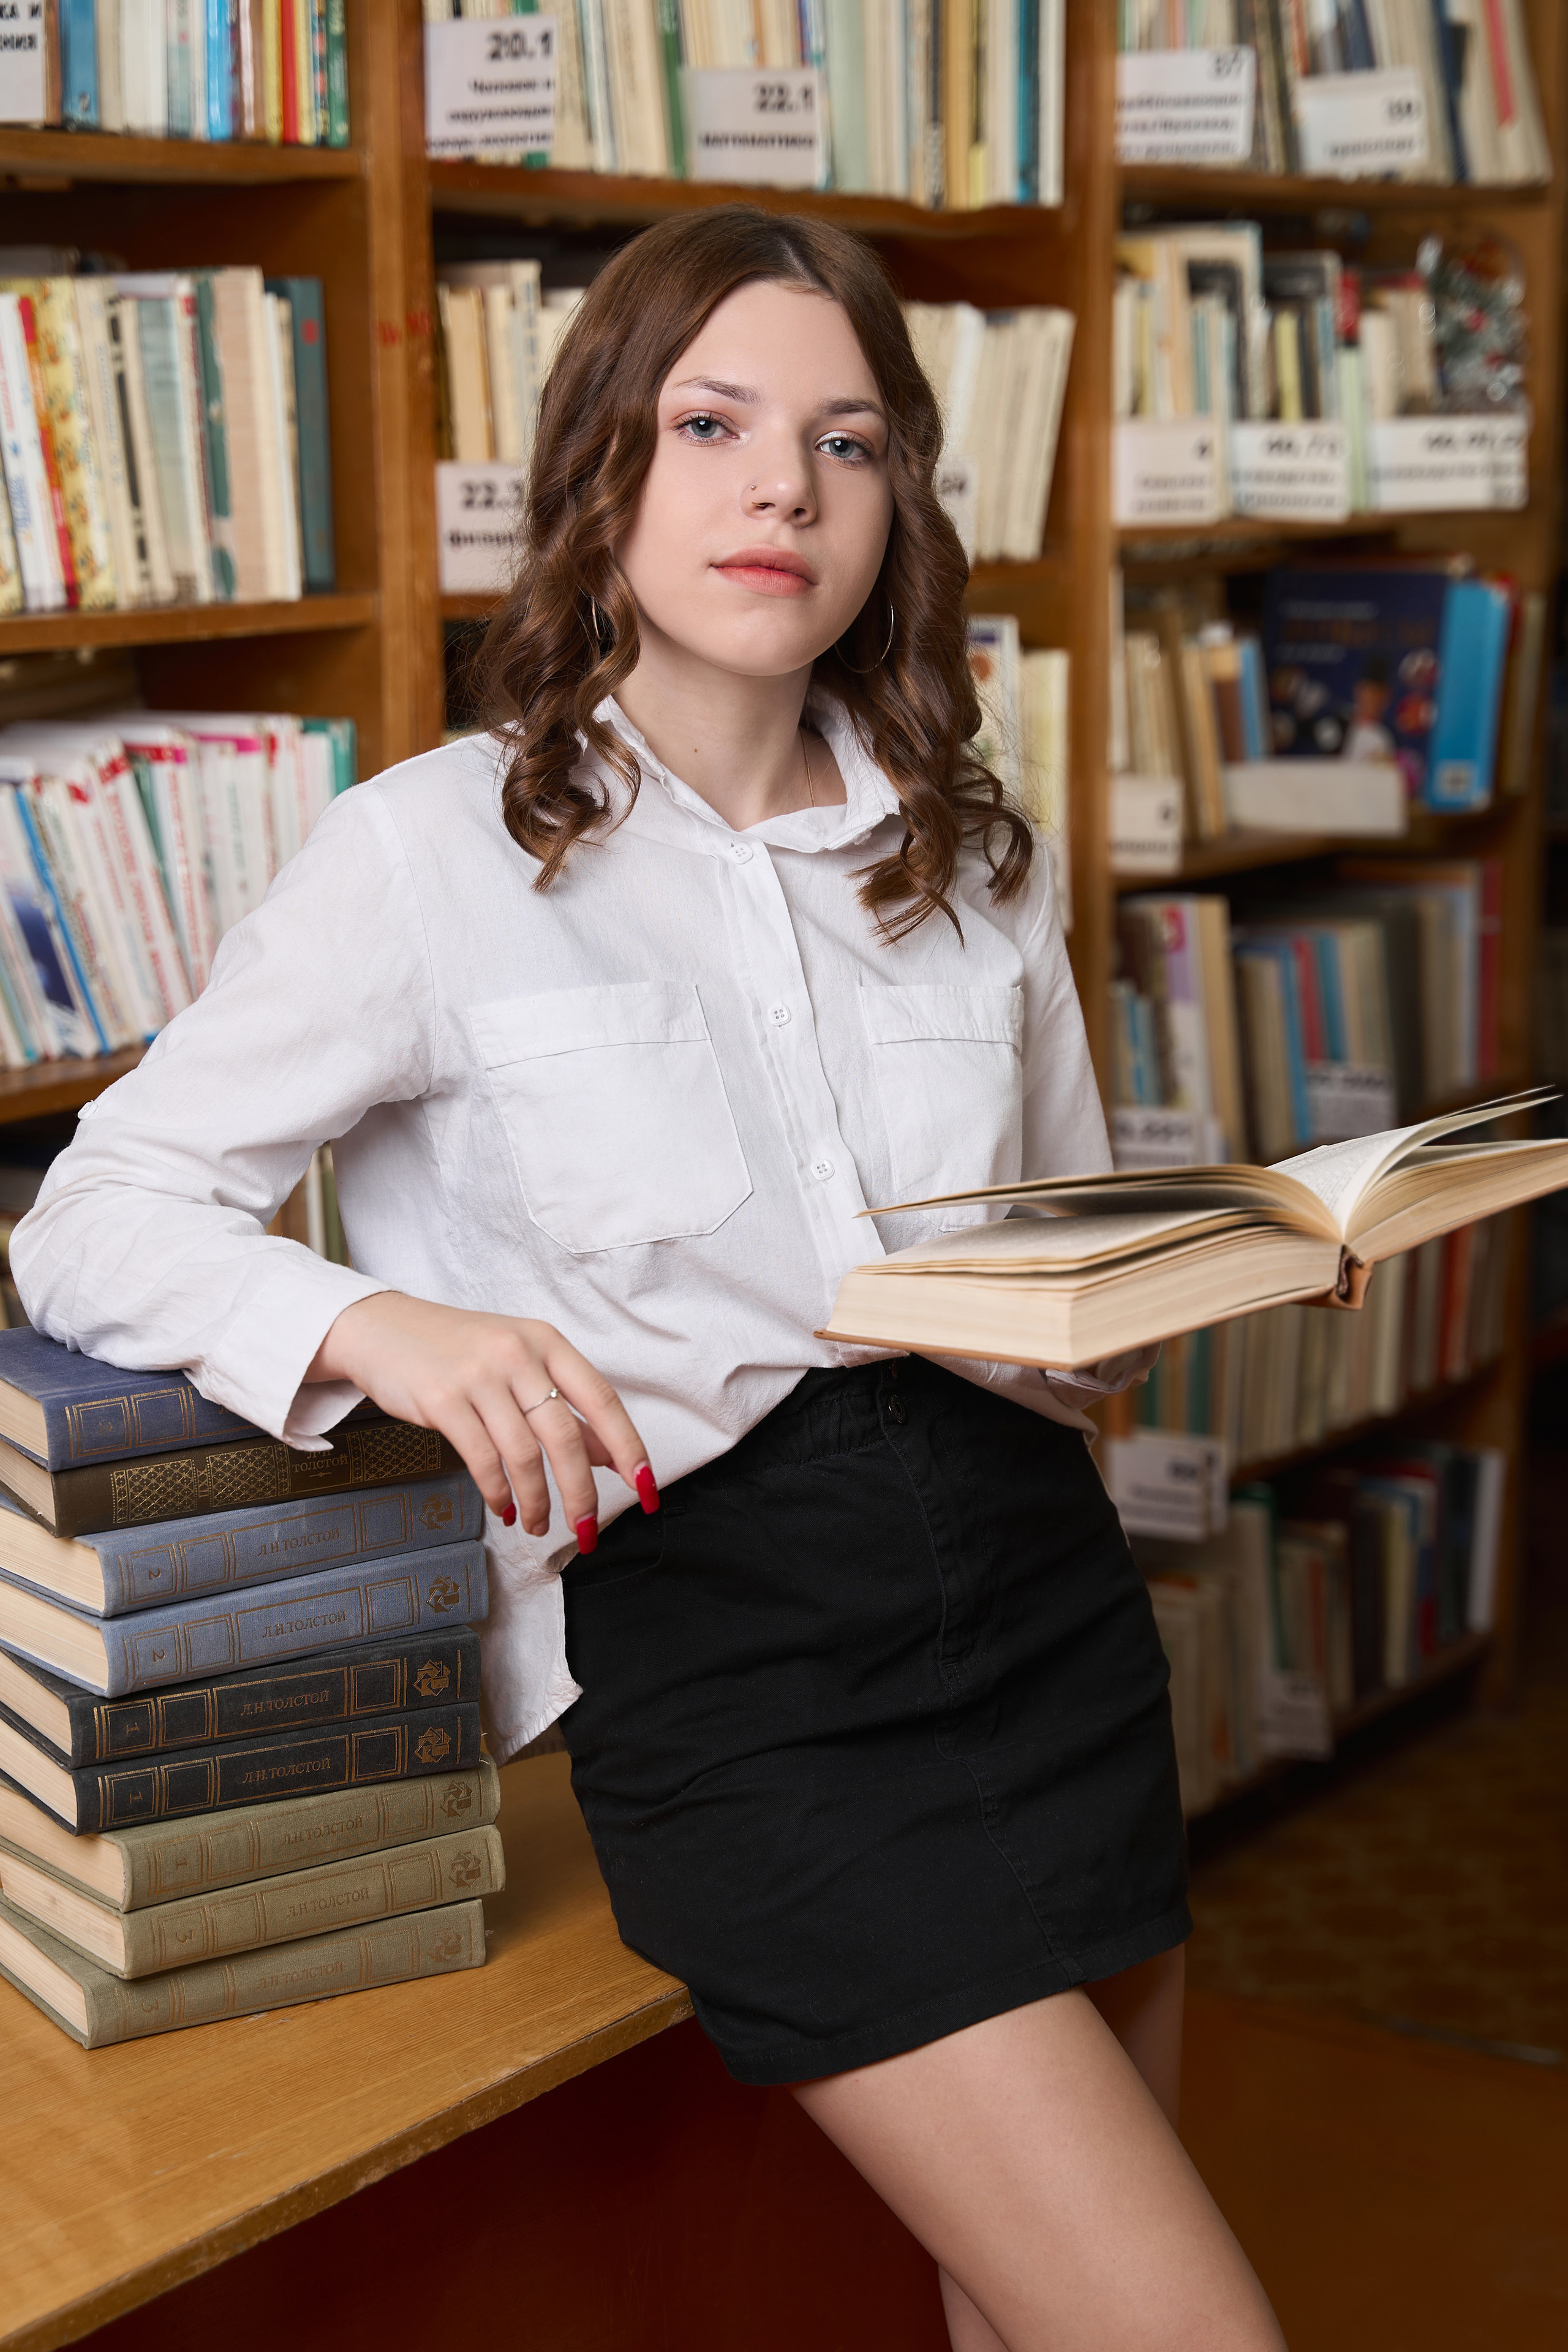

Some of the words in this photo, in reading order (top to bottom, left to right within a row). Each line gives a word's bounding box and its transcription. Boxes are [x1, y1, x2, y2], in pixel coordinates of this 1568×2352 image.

[0, 33, 38, 51] НИЯ
[292, 1453, 349, 1473] ТОЛСТОЙ
[148, 1567, 162, 1581] 2
[153, 1649, 166, 1663] 2
